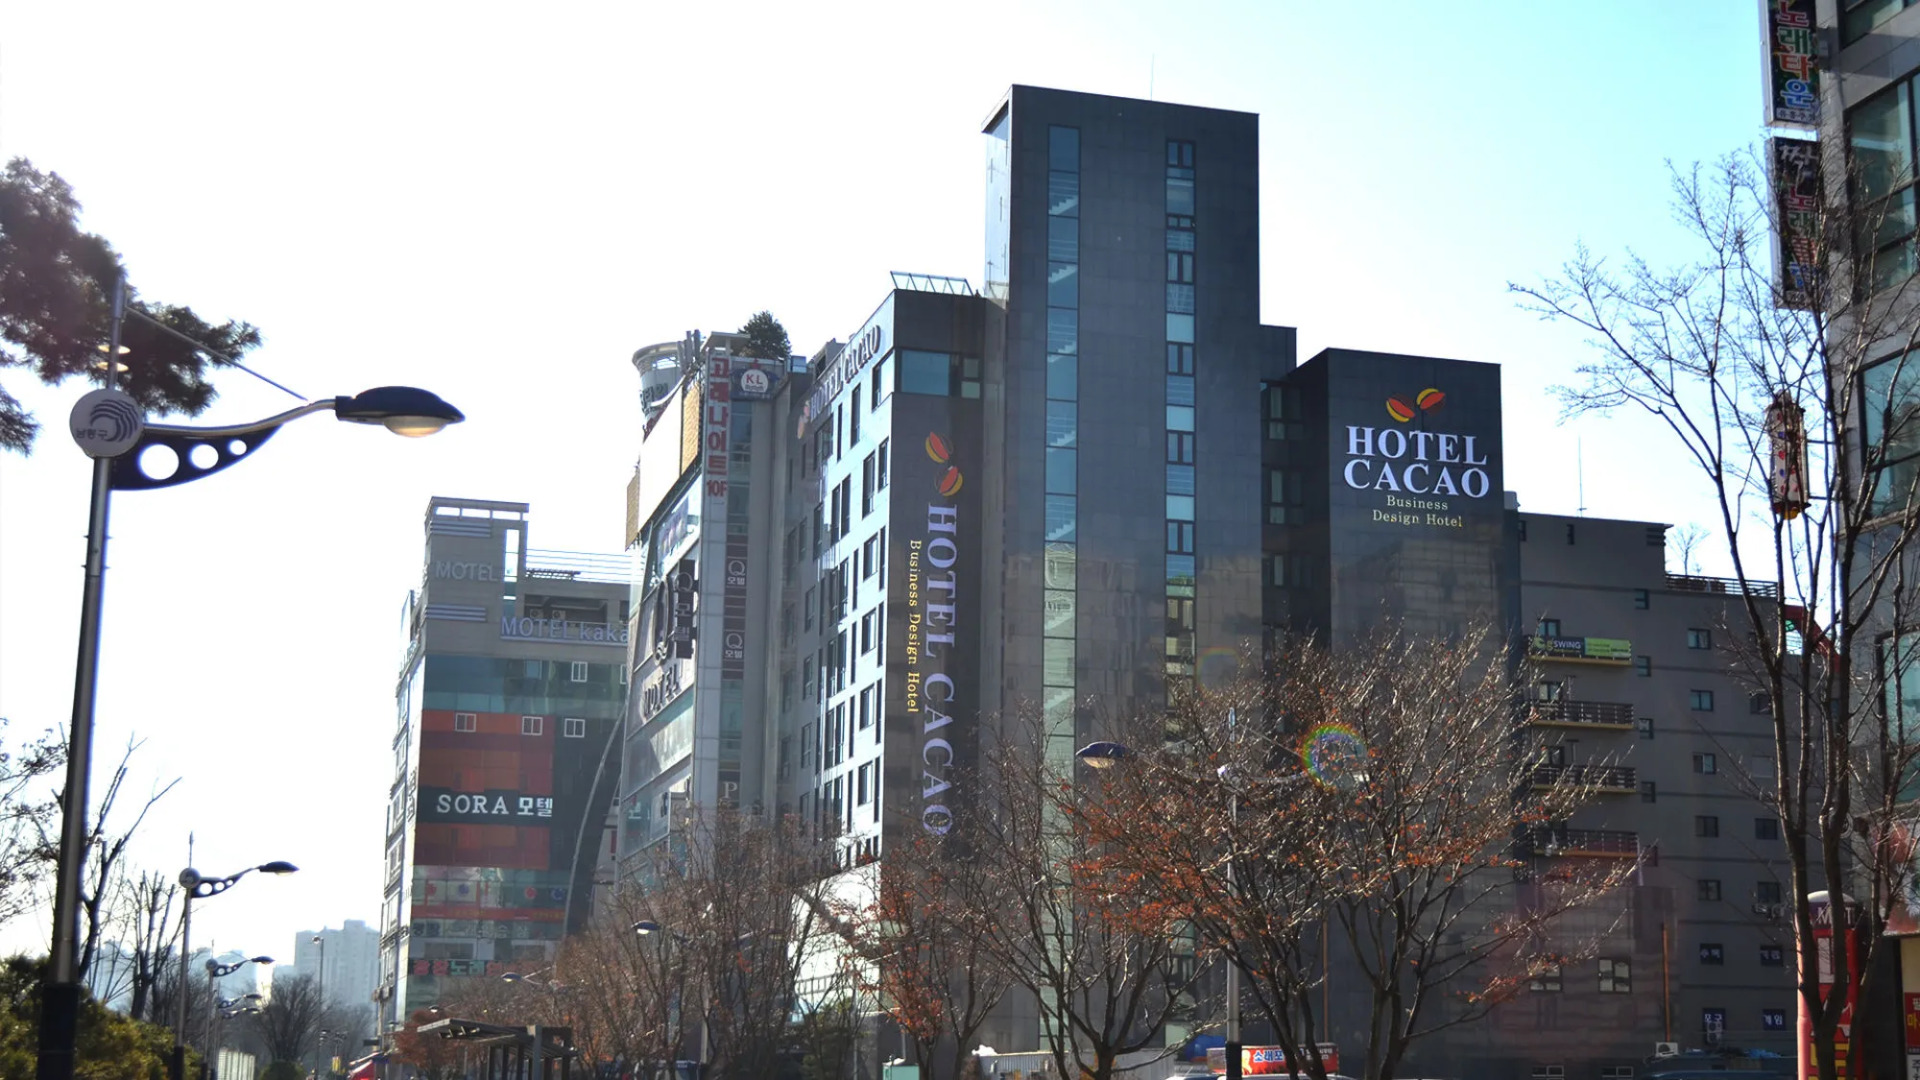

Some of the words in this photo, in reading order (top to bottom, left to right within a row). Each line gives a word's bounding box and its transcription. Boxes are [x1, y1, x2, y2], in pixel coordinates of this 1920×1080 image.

[1777, 0, 1814, 108] 노래타운
[1346, 426, 1487, 465] HOTEL
[1344, 459, 1490, 498] CACAO
[1387, 495, 1448, 510] Business
[1372, 510, 1420, 525] Design
[1427, 514, 1463, 528] Hotel
[434, 561, 499, 582] MOTEL
[728, 560, 745, 576] Q
[909, 539, 922, 607] Business
[727, 576, 745, 586] 모텔
[926, 502, 958, 658] HOTEL
[501, 617, 570, 640] MOTEL
[907, 613, 921, 665] Design
[725, 632, 743, 650] Q
[724, 650, 743, 659] 모텔
[907, 672, 920, 713] Hotel
[923, 673, 955, 835] CACAO
[723, 781, 738, 798] P
[436, 794, 509, 815] SORA
[517, 797, 553, 818] 모텔
